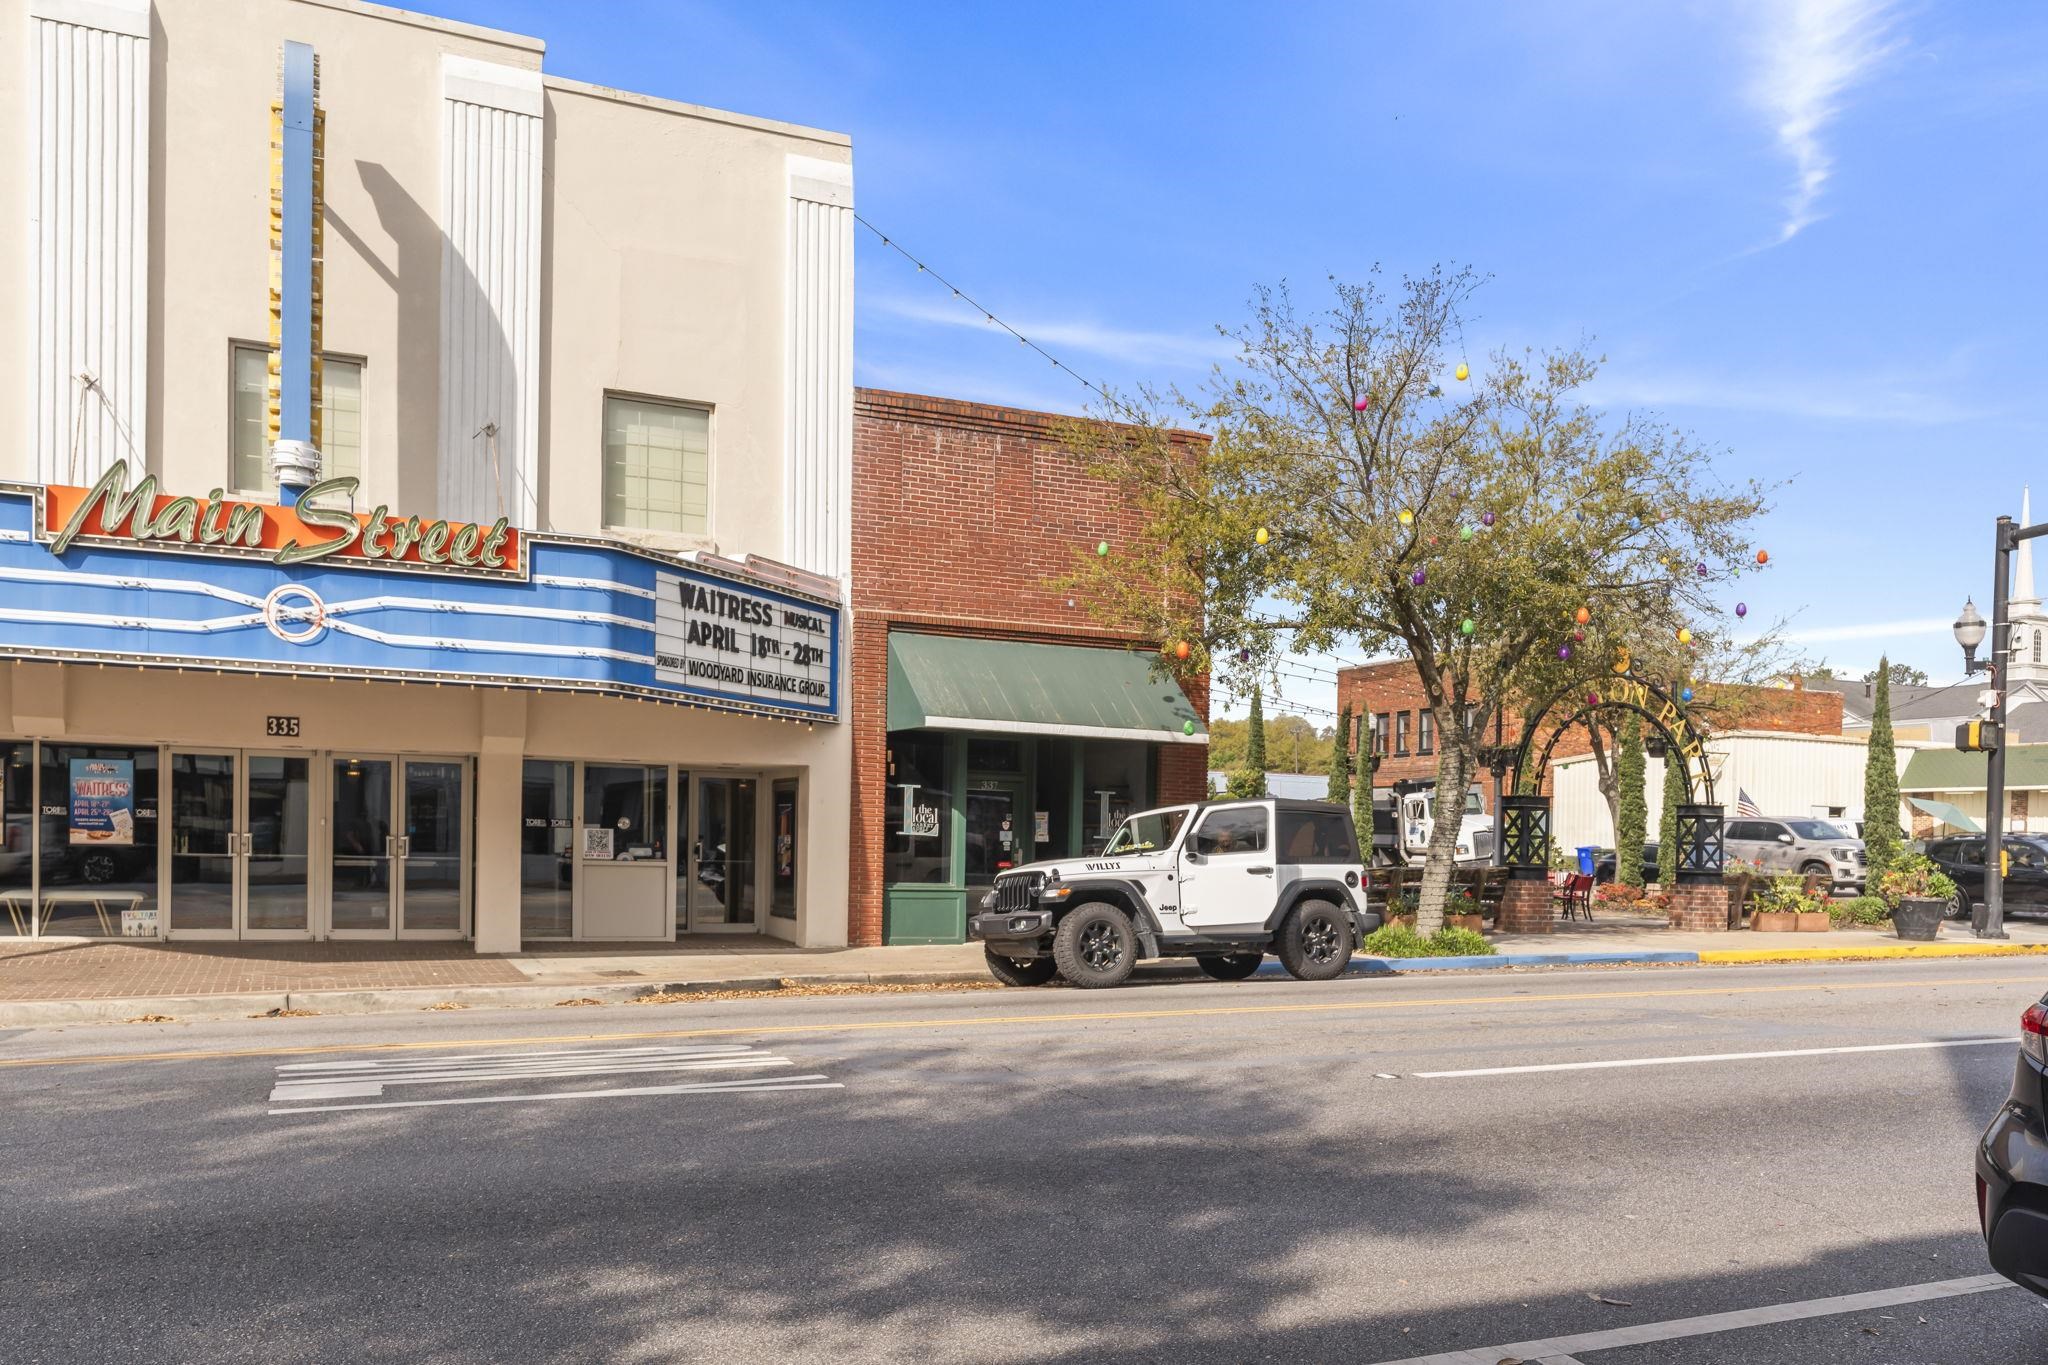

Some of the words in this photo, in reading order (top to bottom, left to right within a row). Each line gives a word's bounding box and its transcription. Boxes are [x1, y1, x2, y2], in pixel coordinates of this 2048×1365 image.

[50, 458, 263, 555] Main
[273, 476, 509, 568] Street
[678, 581, 773, 627] WAITRESS
[784, 610, 825, 633] MUSICAL
[687, 619, 740, 653] APRIL
[751, 633, 780, 659] 18TH
[793, 642, 824, 667] 28TH
[688, 660, 744, 684] WOODYARD
[747, 670, 796, 692] INSURANCE
[798, 679, 825, 698] GROUP
[268, 718, 299, 735] 335
[1656, 699, 1713, 795] PARK
[75, 780, 129, 797] WAITRESS
[981, 781, 999, 790] 337
[912, 807, 938, 823] local
[918, 804, 932, 813] the
[1085, 861, 1121, 871] WILLYS
[1159, 904, 1177, 912] Jeep
